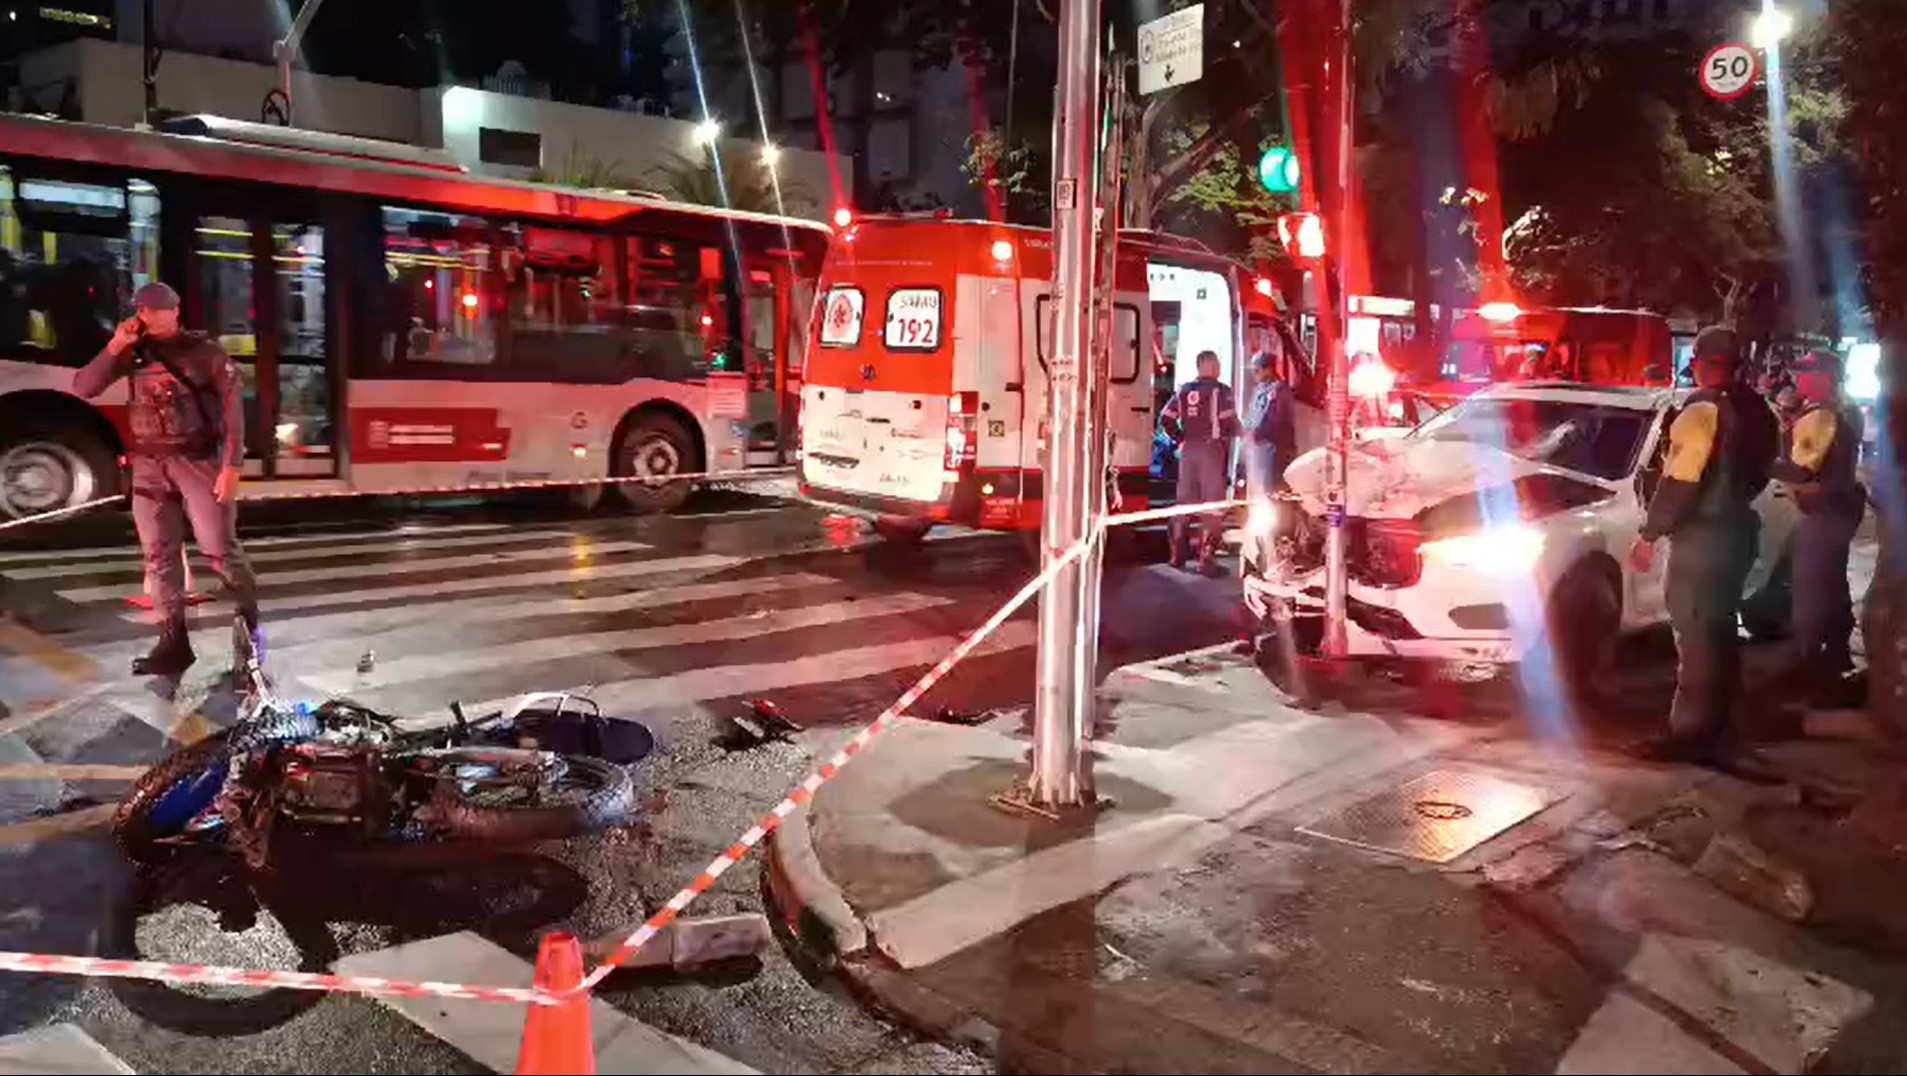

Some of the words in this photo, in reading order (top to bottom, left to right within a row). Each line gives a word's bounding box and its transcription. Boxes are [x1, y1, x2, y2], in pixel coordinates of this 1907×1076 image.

[1711, 56, 1748, 80] 50
[900, 294, 937, 309] SAMU
[898, 318, 933, 343] 192
